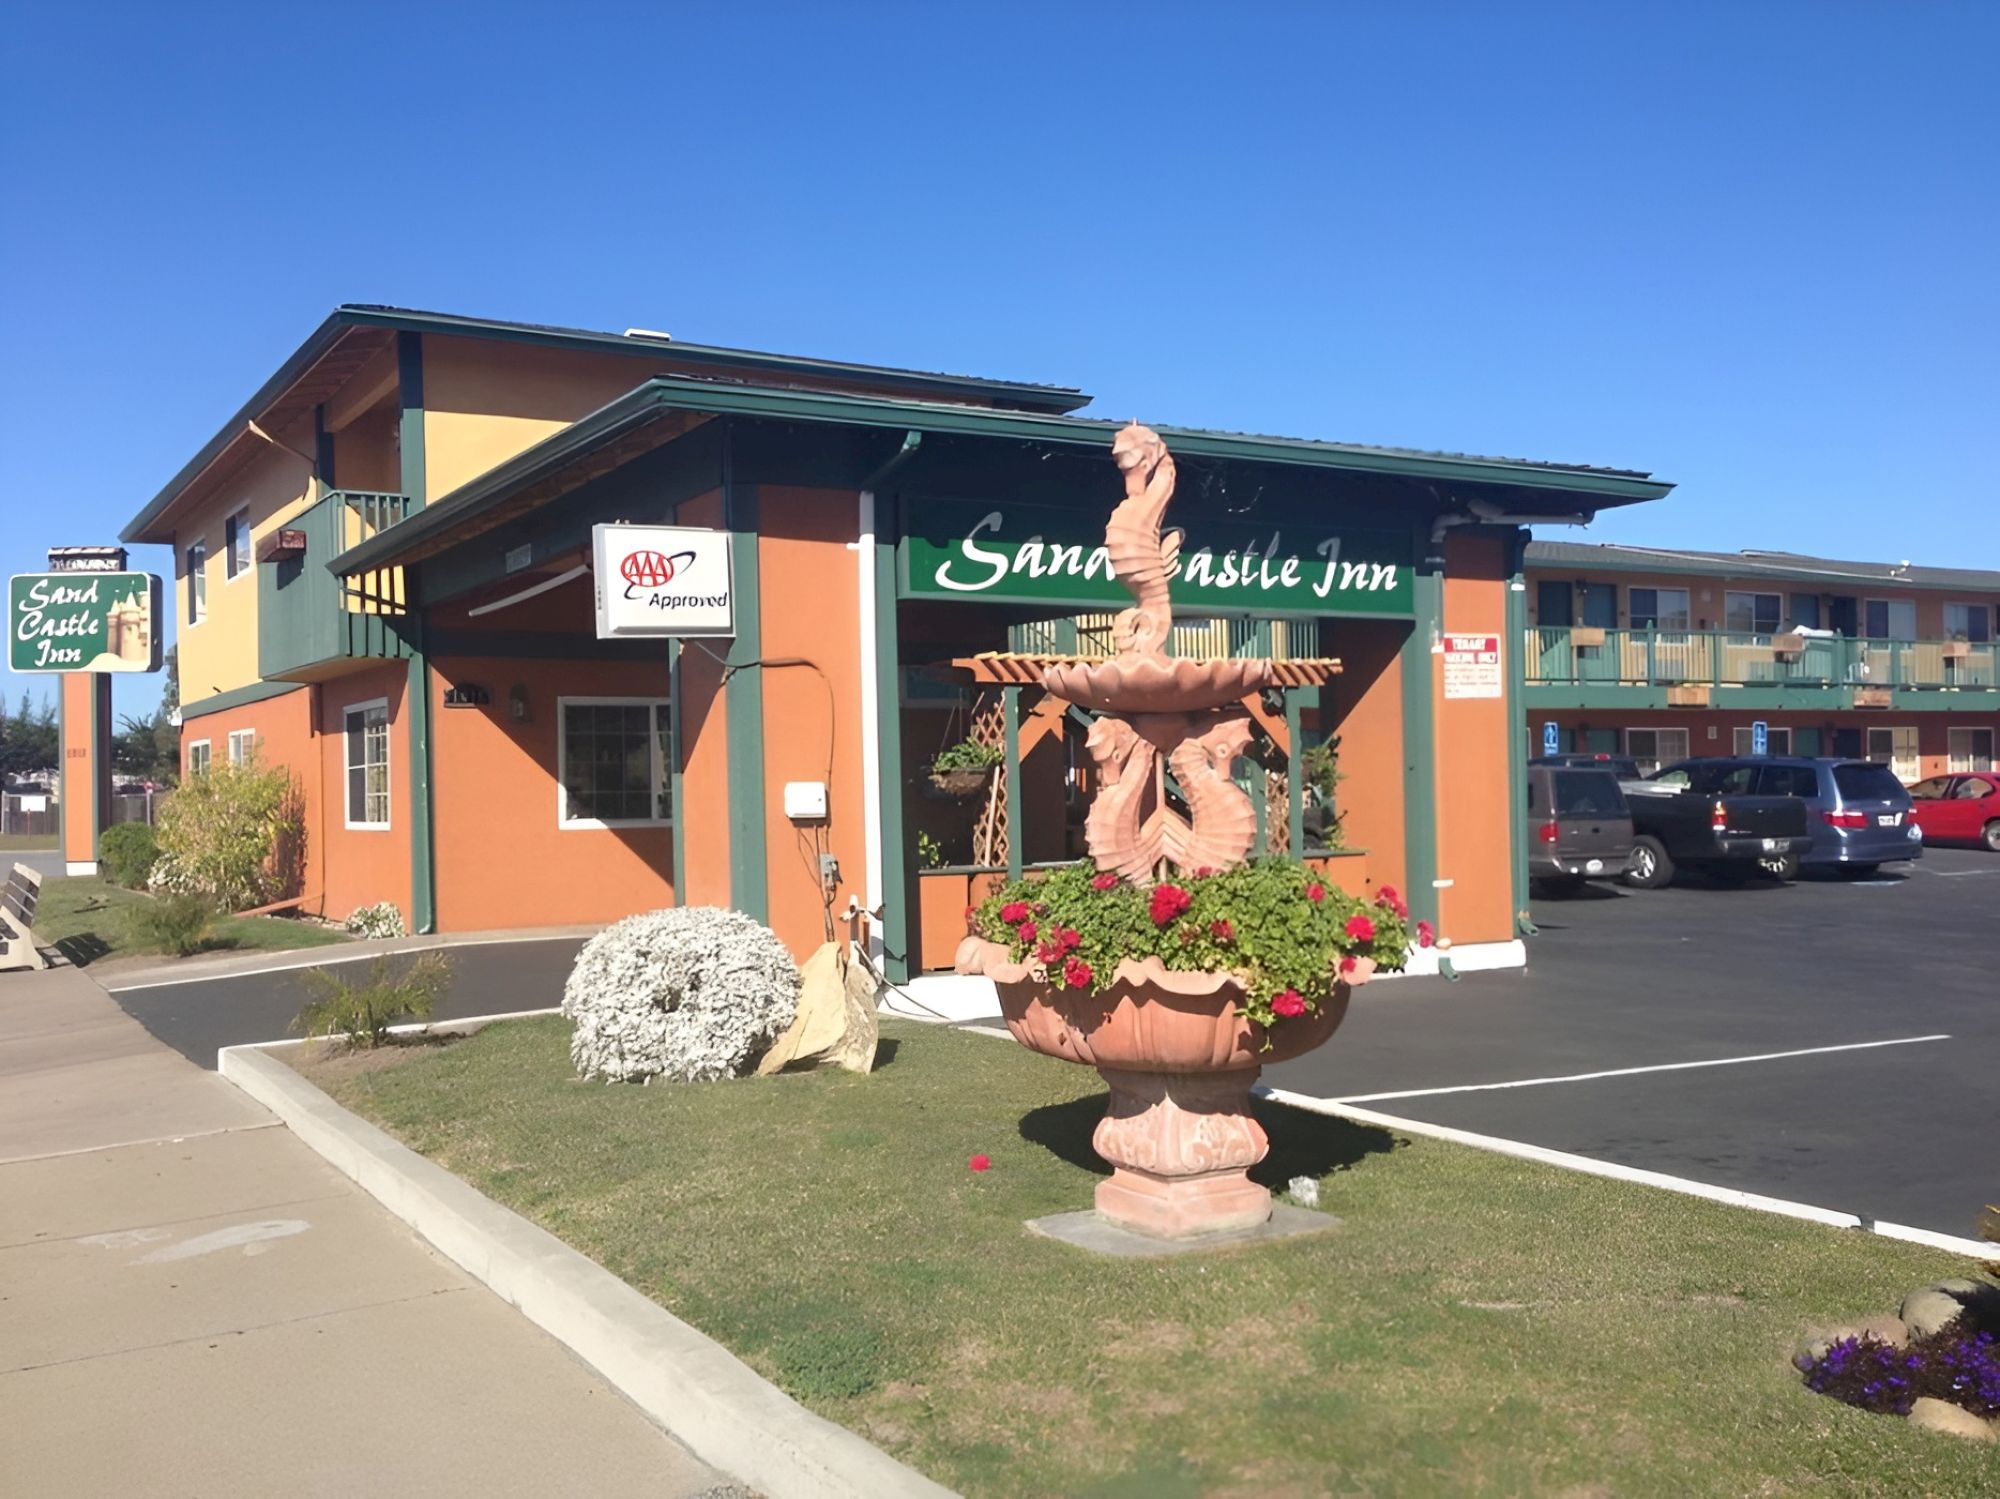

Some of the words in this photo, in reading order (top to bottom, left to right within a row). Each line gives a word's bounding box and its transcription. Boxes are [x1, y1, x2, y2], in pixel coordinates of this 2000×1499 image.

[622, 551, 673, 587] AAA
[1312, 536, 1398, 598] Inn
[18, 578, 98, 612] Sand
[648, 591, 728, 611] Approved
[17, 609, 99, 641] Castle
[34, 638, 81, 667] Inn
